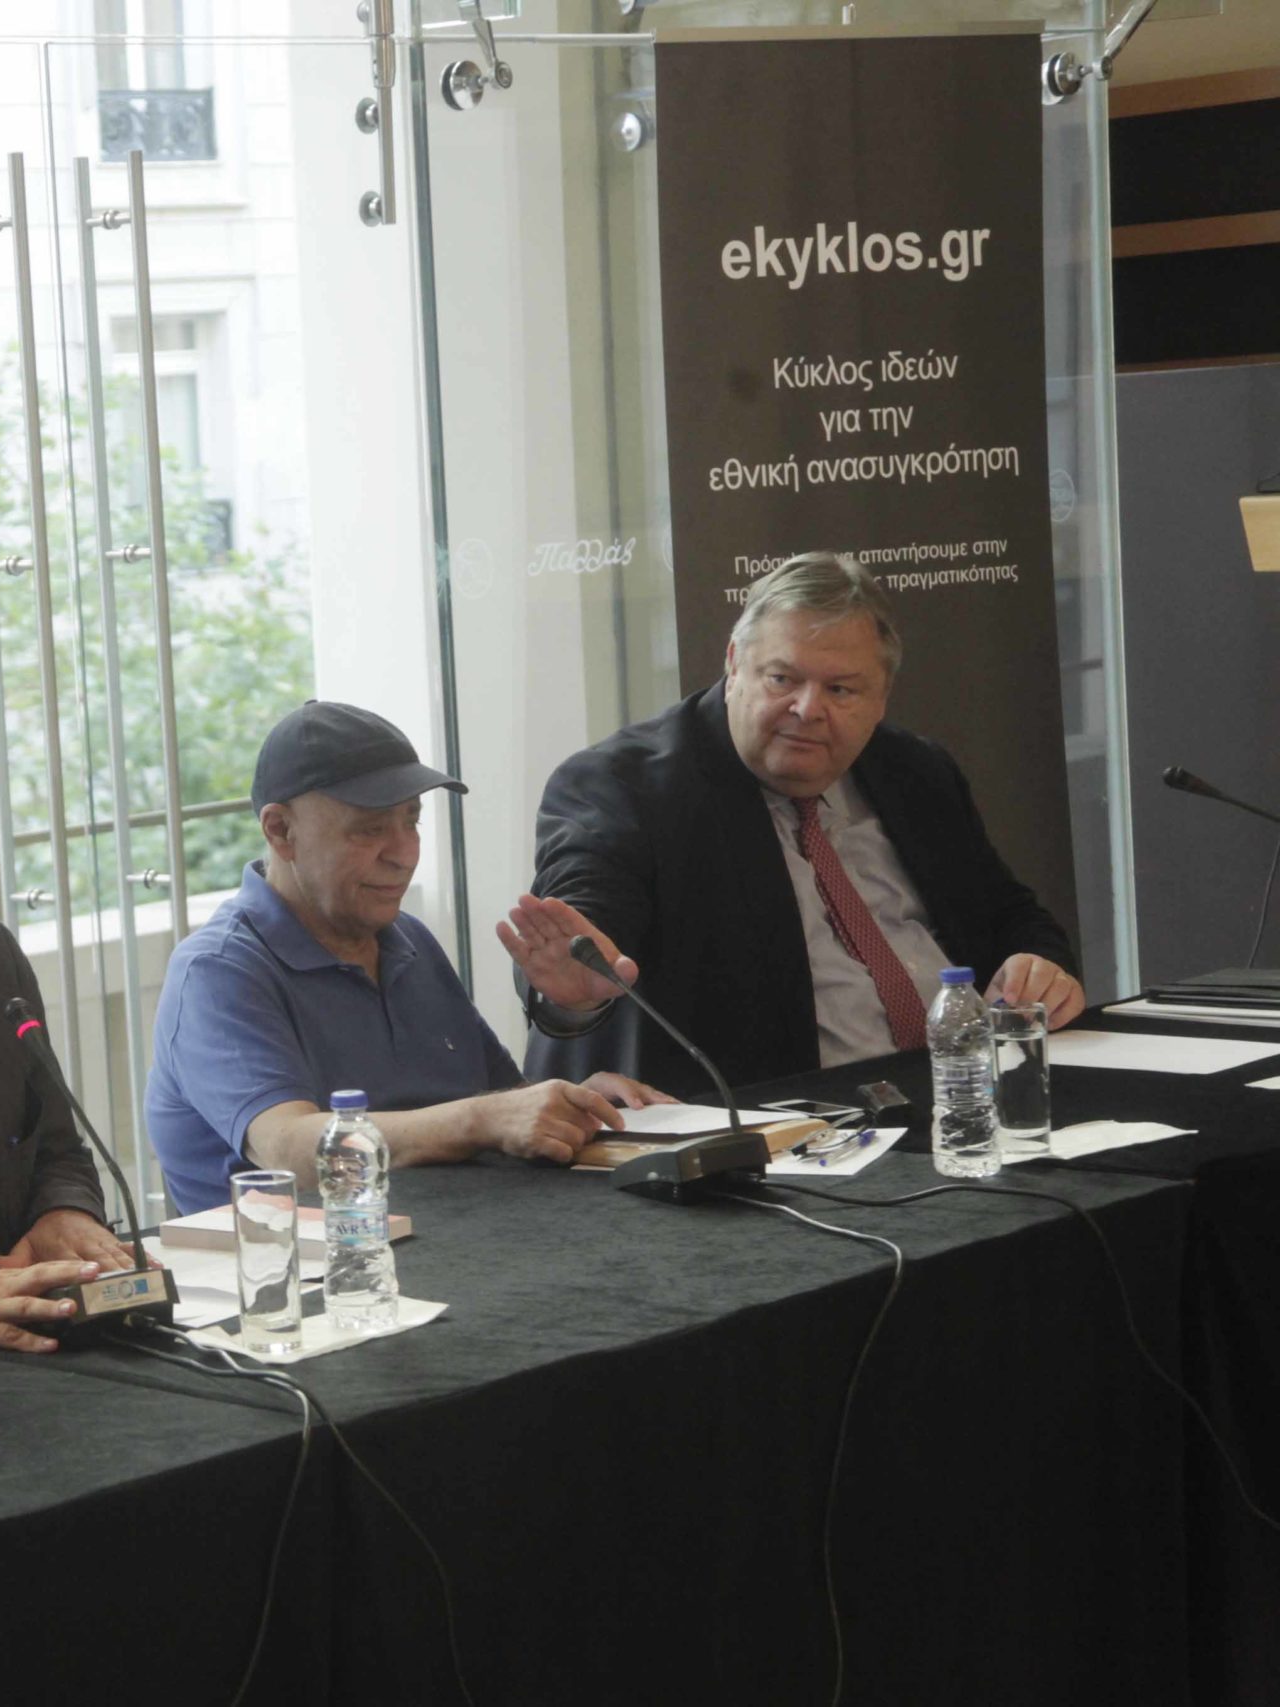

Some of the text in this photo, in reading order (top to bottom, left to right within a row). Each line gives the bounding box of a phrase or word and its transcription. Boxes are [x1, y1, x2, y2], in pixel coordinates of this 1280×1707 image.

[721, 221, 991, 290] ekyklos.gr
[773, 349, 958, 391] Κύκλος ιδεών
[819, 406, 914, 442] για την
[709, 443, 1020, 492] εθνική ανασυγκρότηση
[859, 540, 968, 564] απαντήσουμε
[972, 538, 1008, 559] στην
[886, 563, 1019, 592] πραγματικότητας
